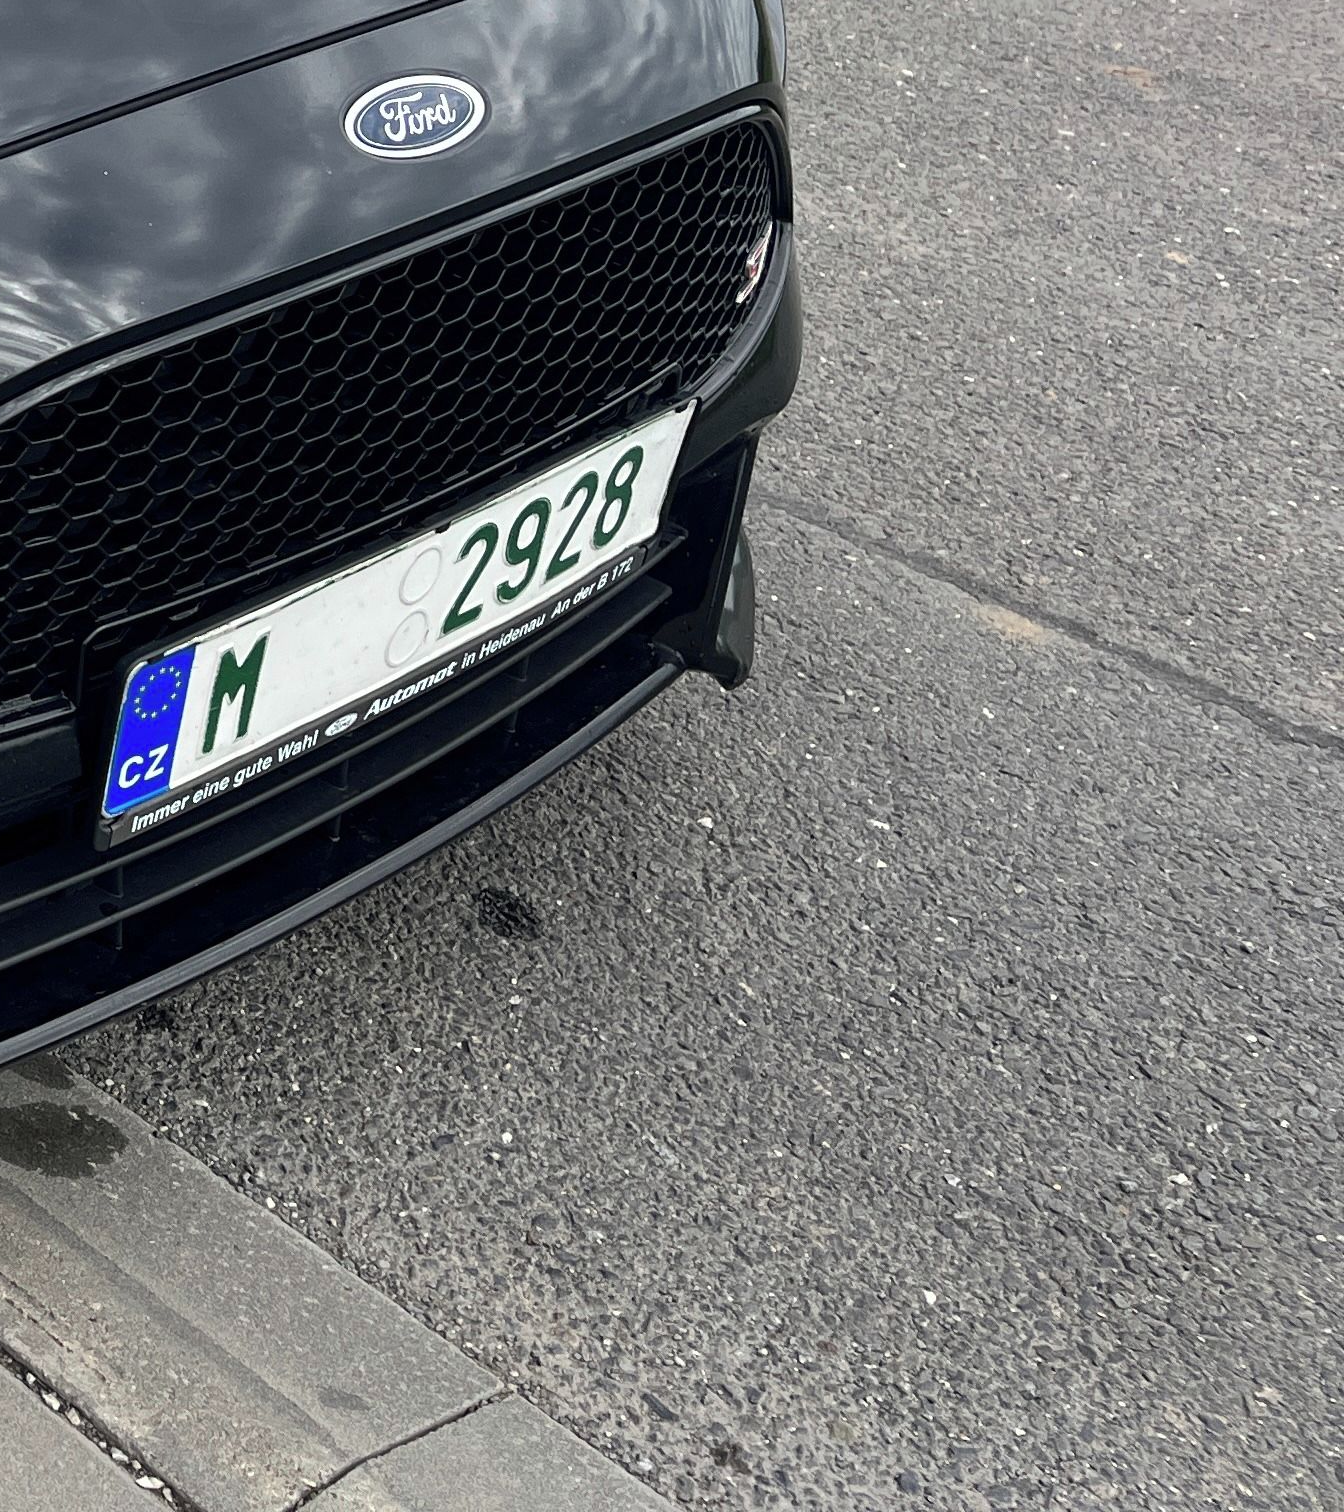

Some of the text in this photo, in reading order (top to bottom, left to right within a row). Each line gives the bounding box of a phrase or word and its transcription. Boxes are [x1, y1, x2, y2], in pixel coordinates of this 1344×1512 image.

[379, 91, 456, 142] Ford
[201, 445, 645, 755] M 2928
[118, 744, 169, 789] CZ
[130, 795, 191, 833] Immer
[192, 778, 230, 805] eine
[232, 754, 273, 788] gute
[277, 729, 320, 763] Wahl
[363, 660, 458, 720] Automot
[461, 652, 476, 670] in
[478, 614, 546, 660] Heidenau
[551, 601, 571, 619] An
[572, 585, 595, 607] der
[596, 573, 609, 590] B
[612, 556, 634, 581] 172
